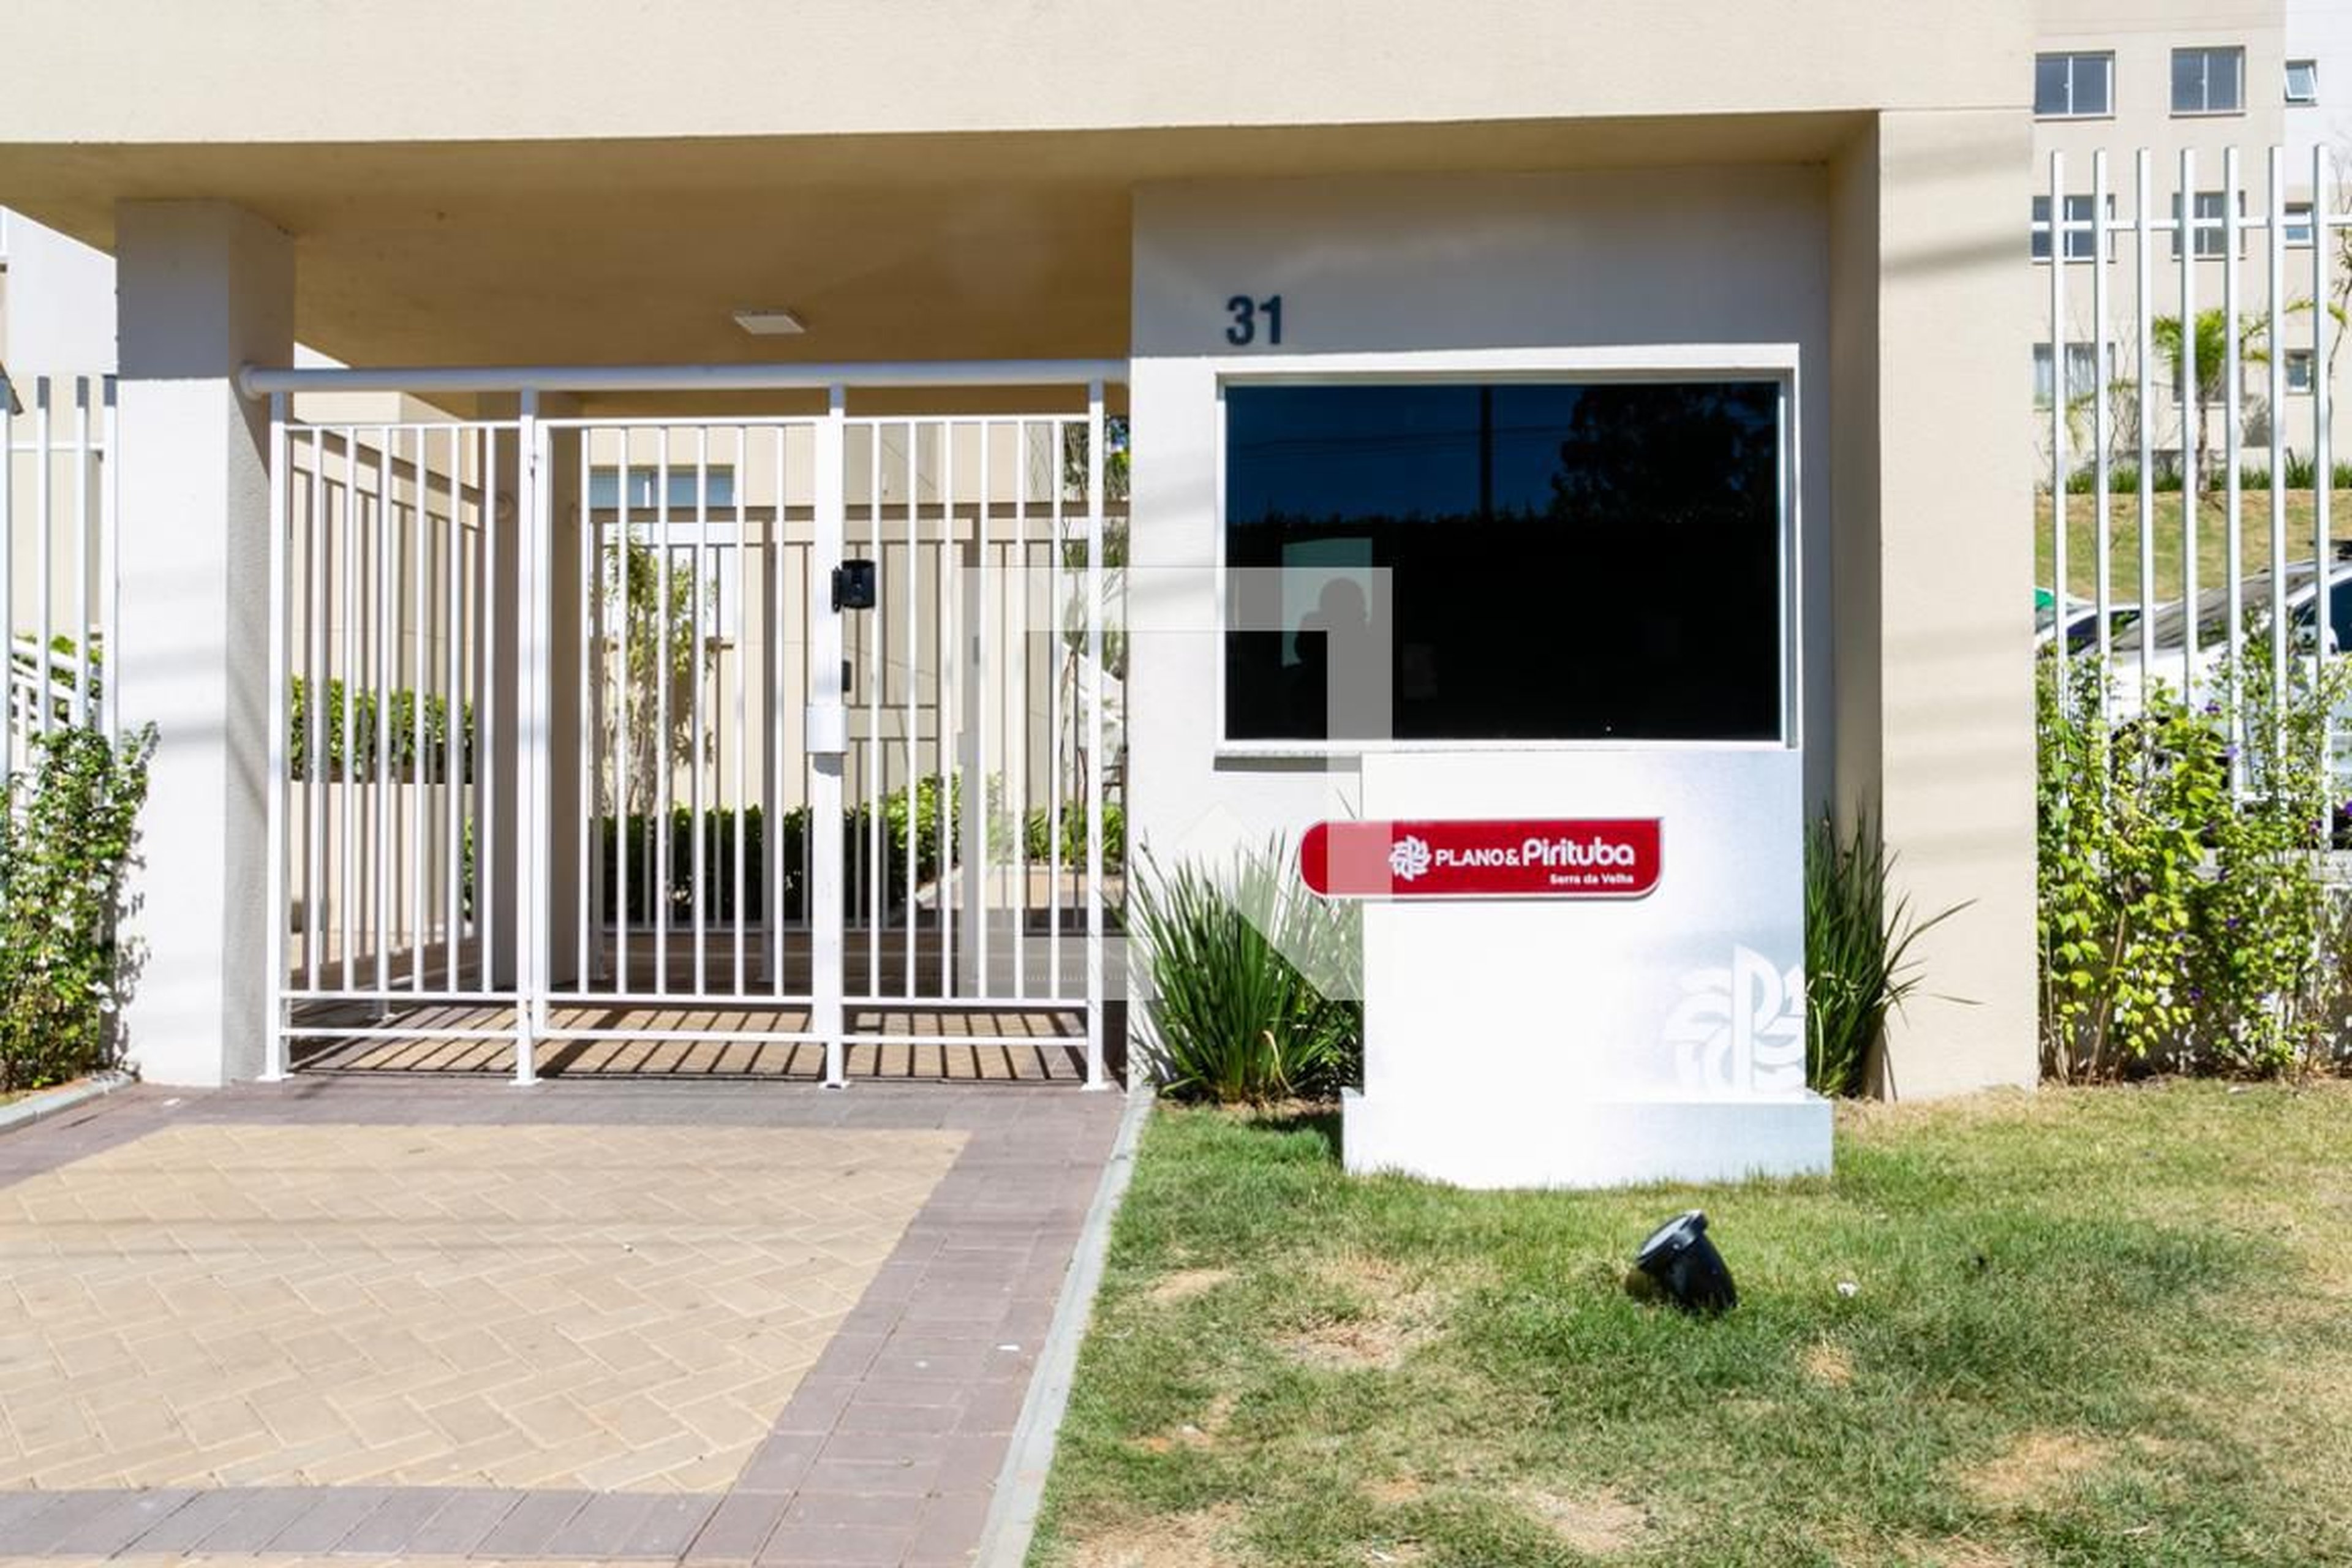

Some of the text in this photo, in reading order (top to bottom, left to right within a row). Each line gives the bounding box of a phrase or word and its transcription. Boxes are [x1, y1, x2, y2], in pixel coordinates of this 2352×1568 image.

[1226, 295, 1281, 346] 31
[1550, 873, 1580, 884] Serra
[1583, 873, 1598, 884] da
